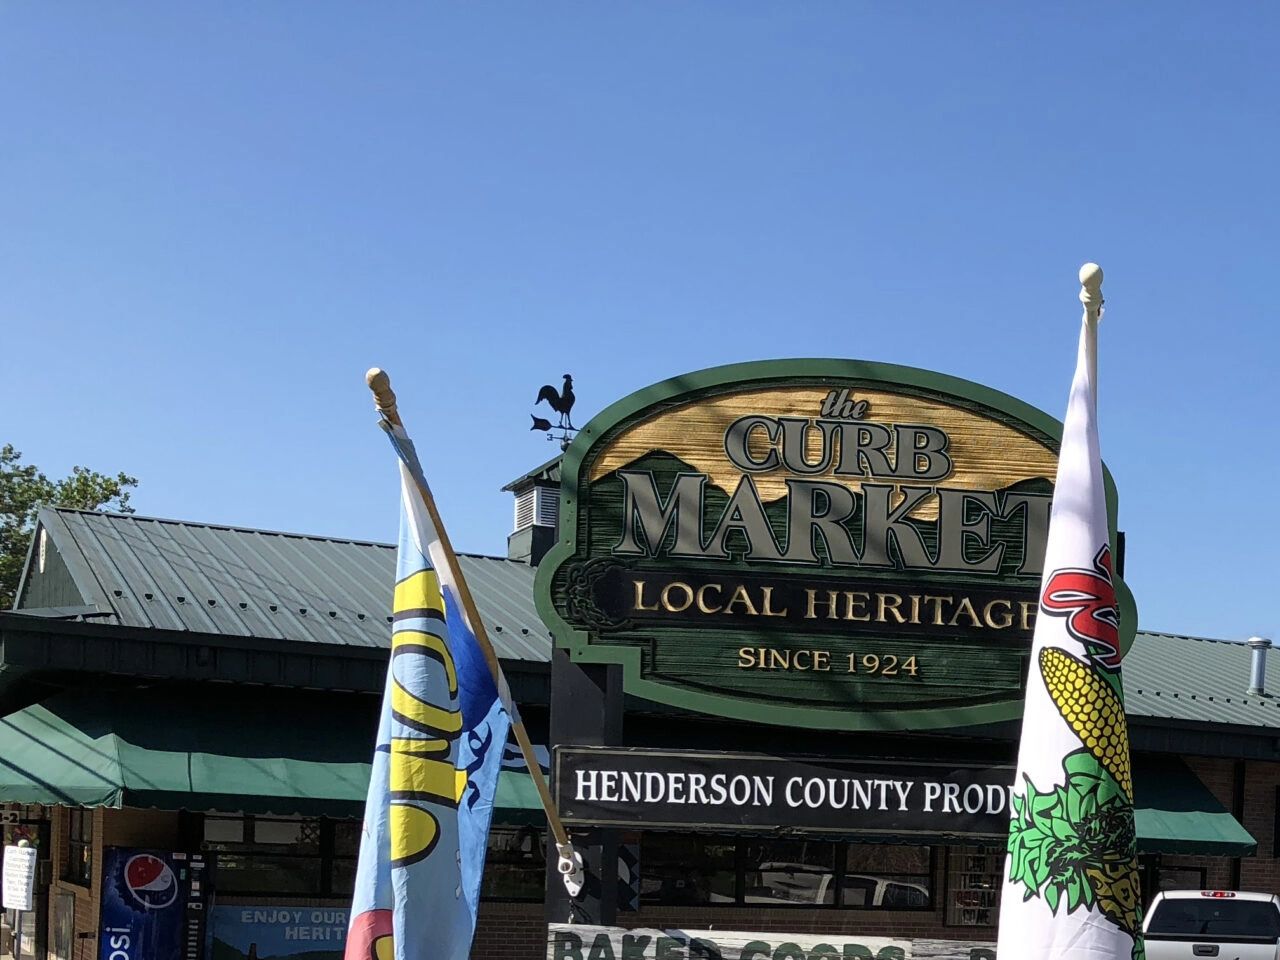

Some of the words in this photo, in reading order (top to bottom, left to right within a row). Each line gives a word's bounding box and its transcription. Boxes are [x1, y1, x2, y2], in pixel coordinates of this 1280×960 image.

[820, 390, 868, 419] the
[724, 415, 952, 480] CURB
[613, 470, 1053, 576] MARKET
[633, 580, 787, 619] LOCAL
[804, 588, 1040, 631] HERITAGE
[738, 647, 831, 672] SINCE
[846, 653, 919, 677] 1924
[575, 769, 774, 807] HENDERSON
[785, 776, 915, 812] COUNTY
[241, 911, 302, 923] ENJOY
[311, 911, 346, 924] OUR
[285, 926, 344, 940] HERIT
